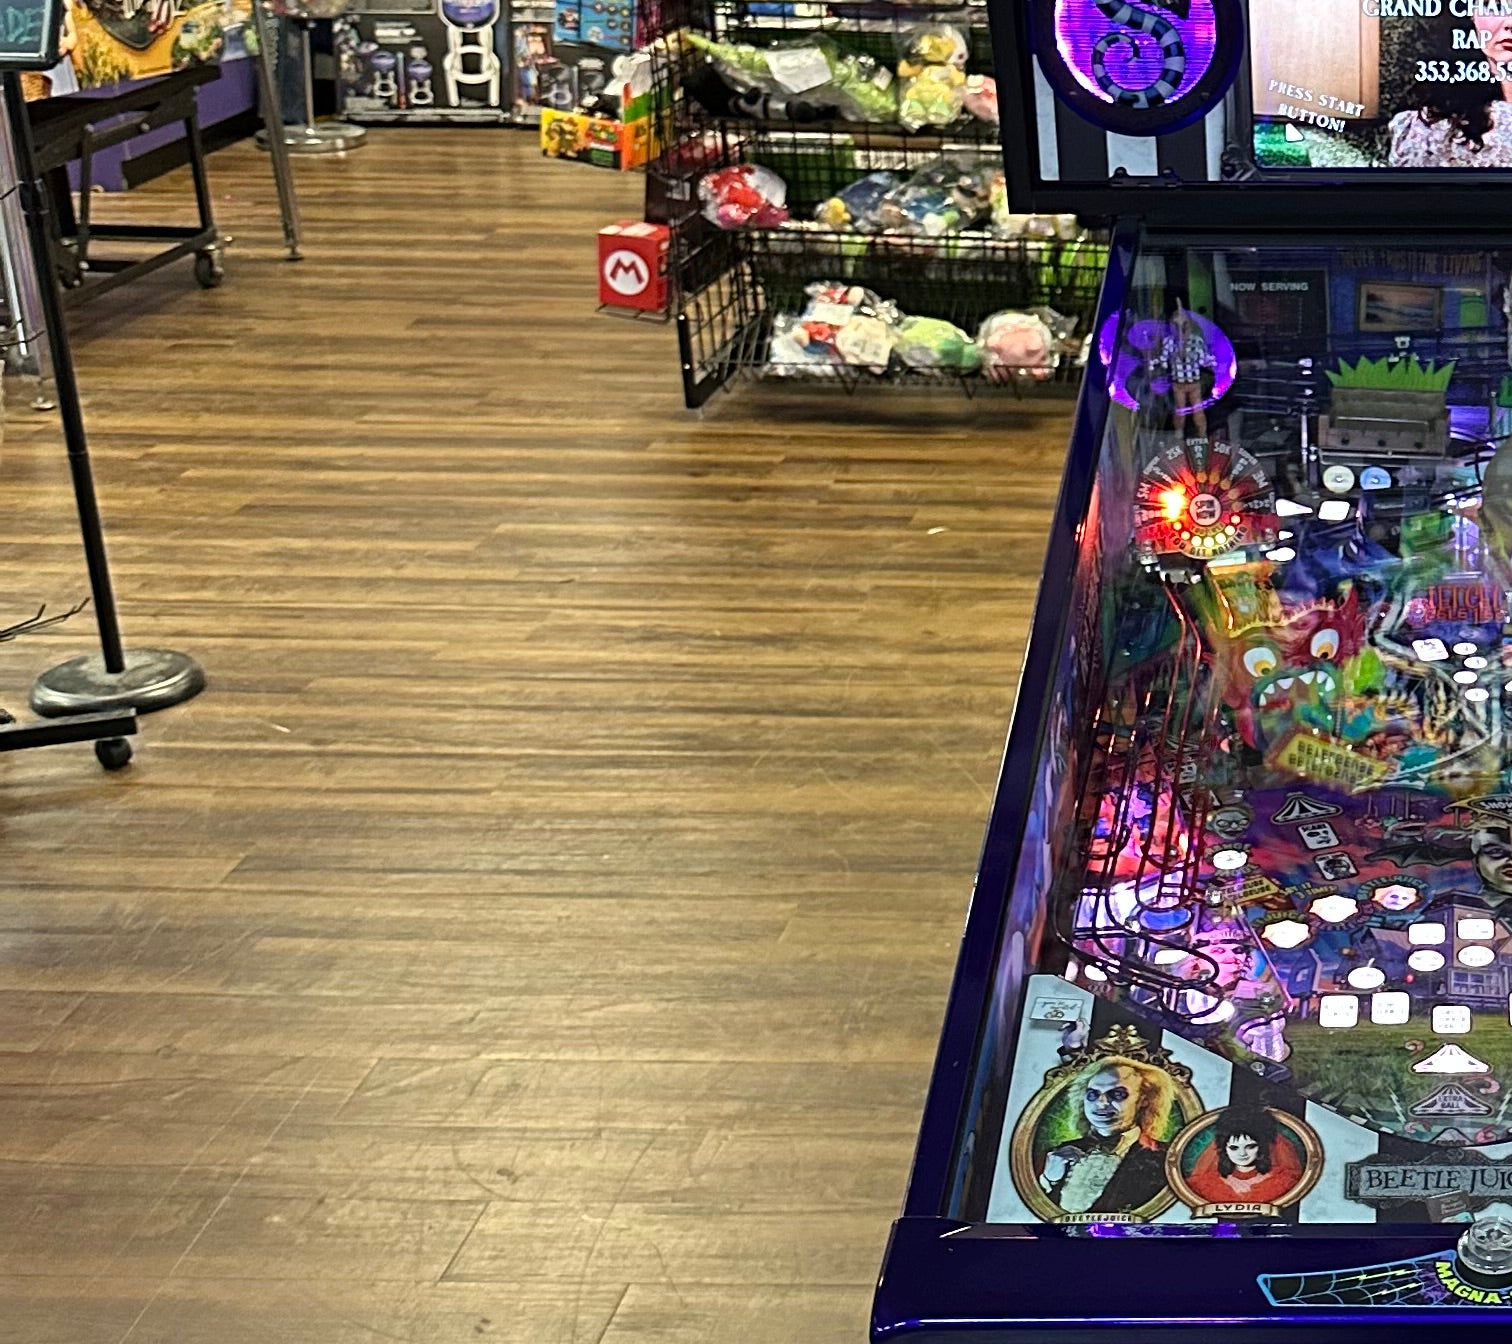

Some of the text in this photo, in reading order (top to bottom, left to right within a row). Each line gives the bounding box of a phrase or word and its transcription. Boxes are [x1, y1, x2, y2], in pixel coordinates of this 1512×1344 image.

[1452, 29, 1493, 49] RAP
[1268, 79, 1366, 117] PRESS START
[1278, 103, 1346, 133] BUTTON!
[1230, 282, 1309, 292] NOW SERVING
[1367, 1169, 1461, 1191] BEETLE
[1215, 1204, 1262, 1212] LYDIA
